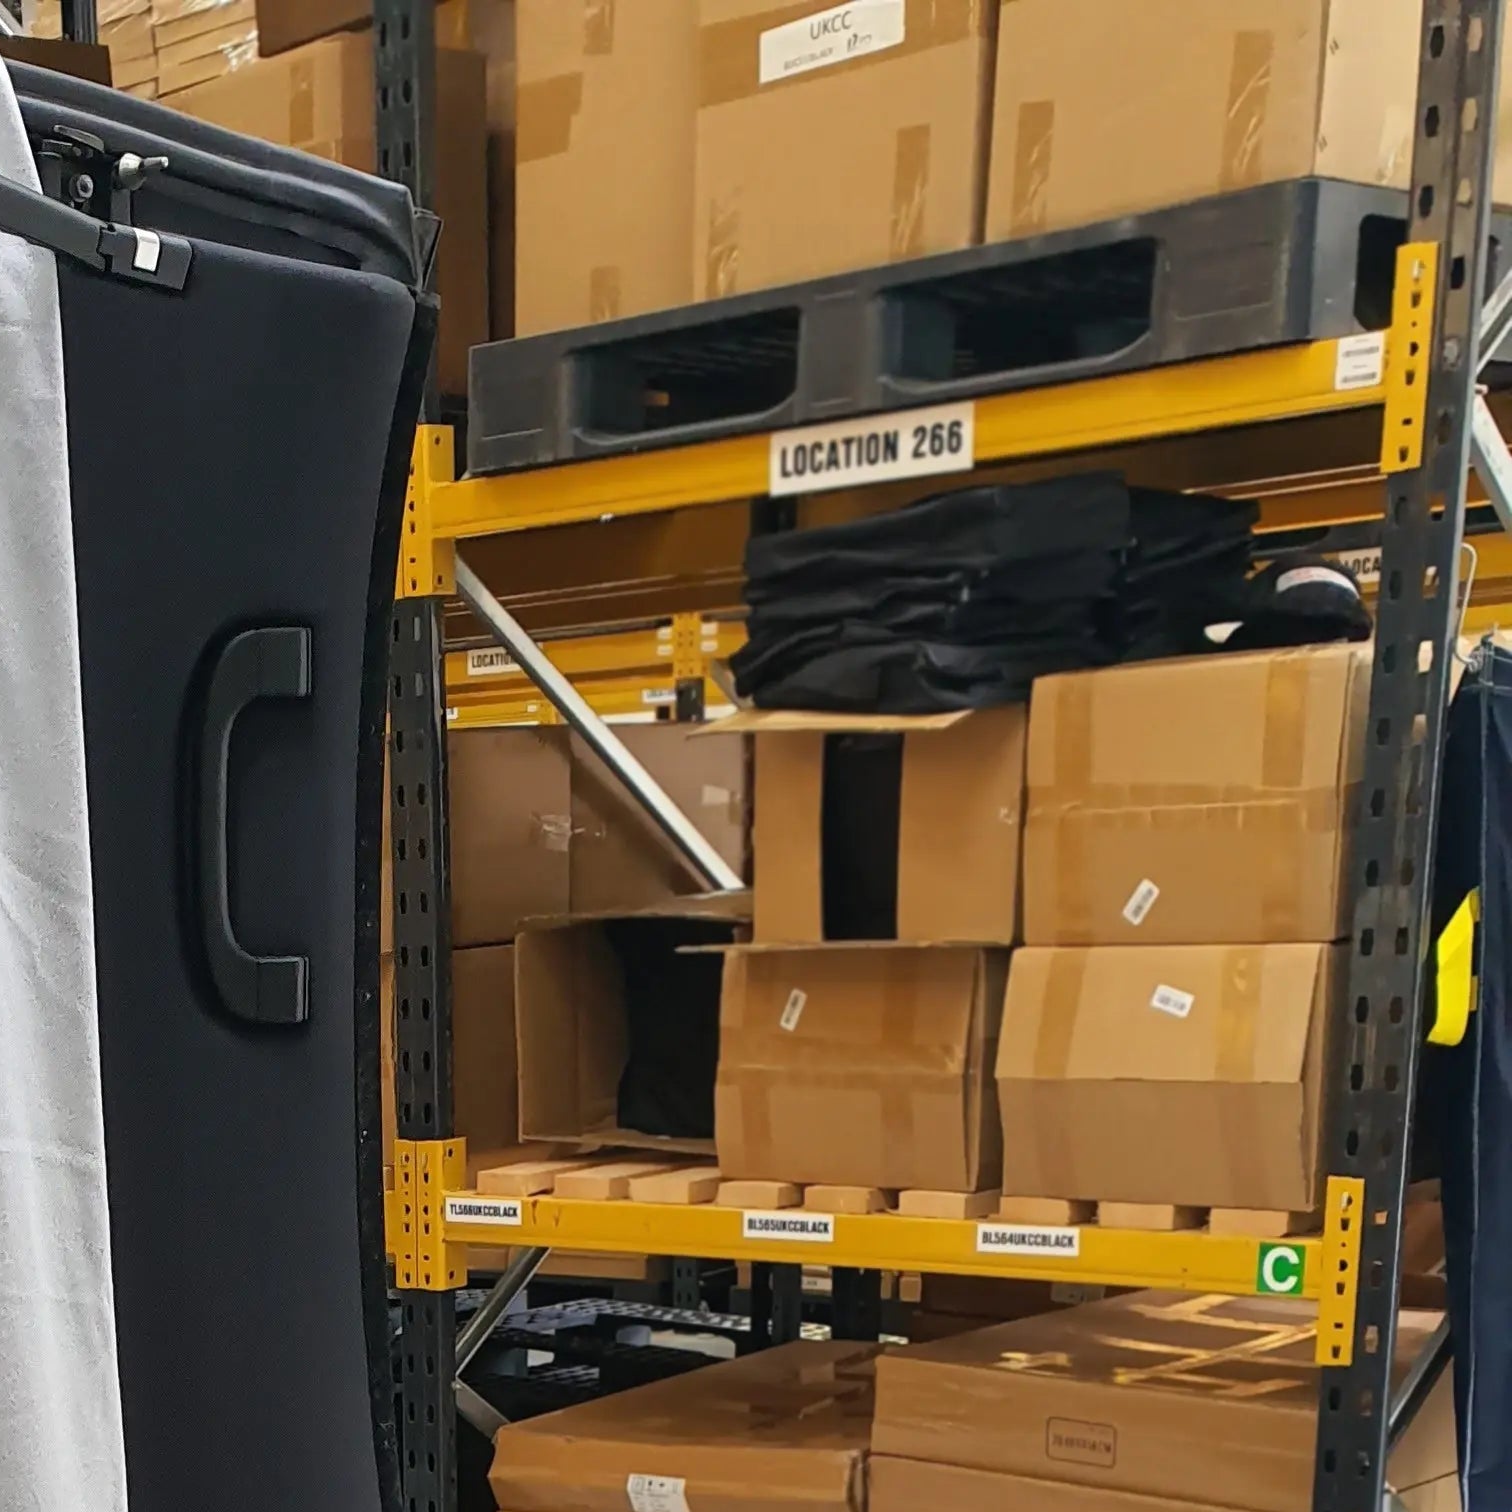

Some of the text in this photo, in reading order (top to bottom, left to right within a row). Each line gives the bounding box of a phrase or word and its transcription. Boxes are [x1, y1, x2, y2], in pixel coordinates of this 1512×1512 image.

[810, 11, 852, 40] UKCC
[780, 420, 963, 478] LOCATION 266
[471, 653, 514, 668] LOCATIO
[1263, 1246, 1299, 1292] C
